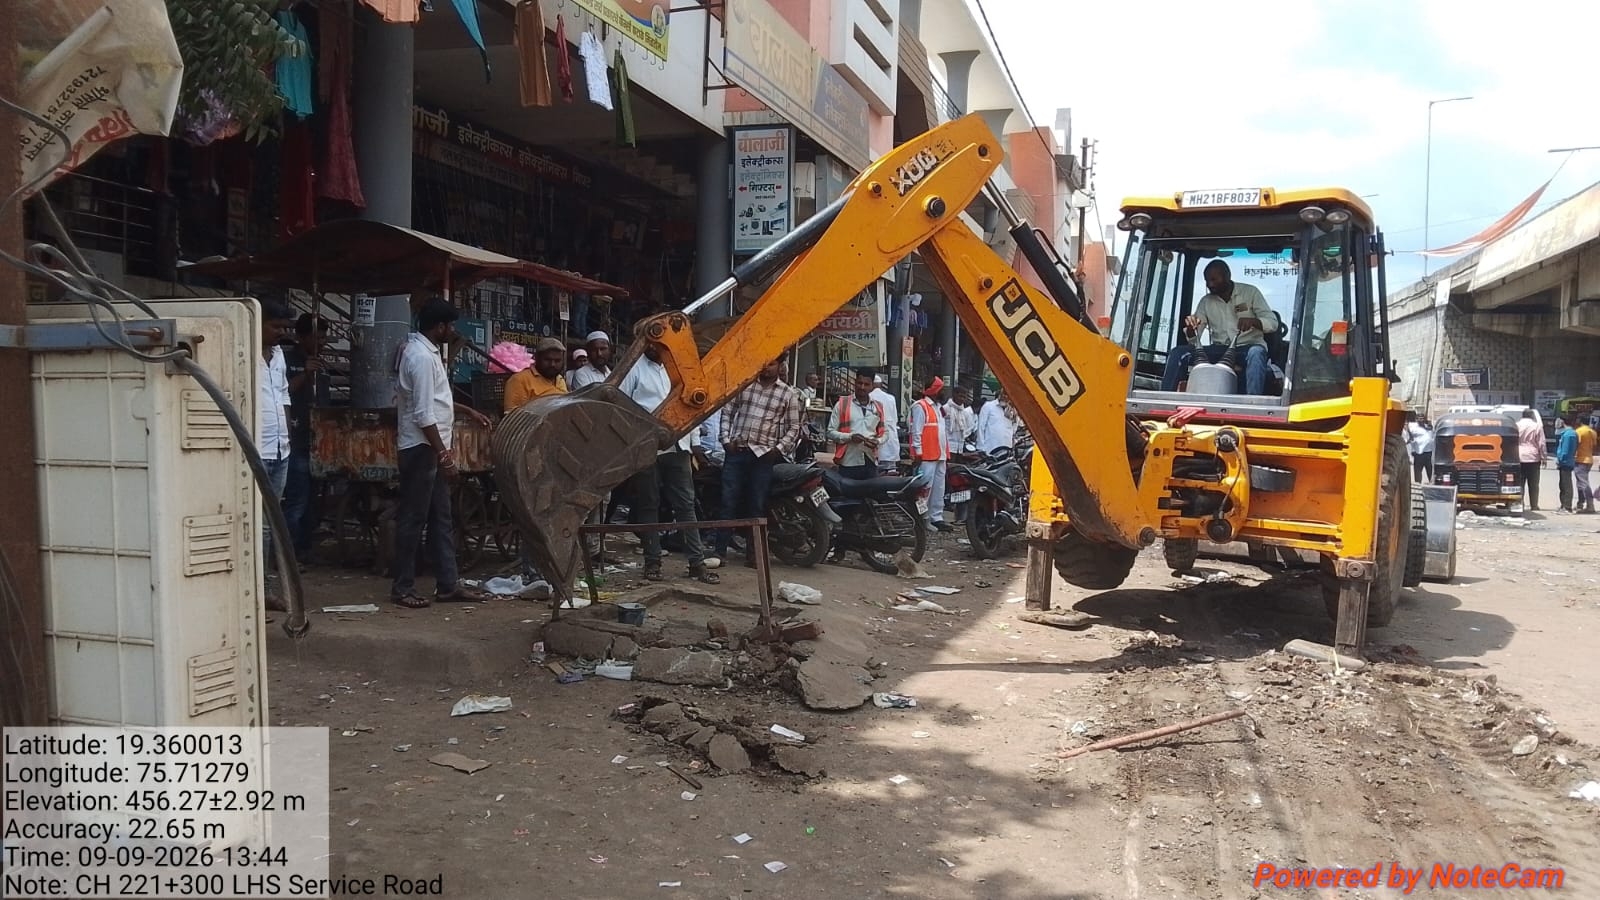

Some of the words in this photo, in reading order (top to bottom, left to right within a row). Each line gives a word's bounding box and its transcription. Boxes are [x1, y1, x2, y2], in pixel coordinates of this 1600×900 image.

[738, 130, 786, 152] बालाजी
[1189, 192, 1259, 205] MH21BF8037
[992, 294, 1080, 408] JCB
